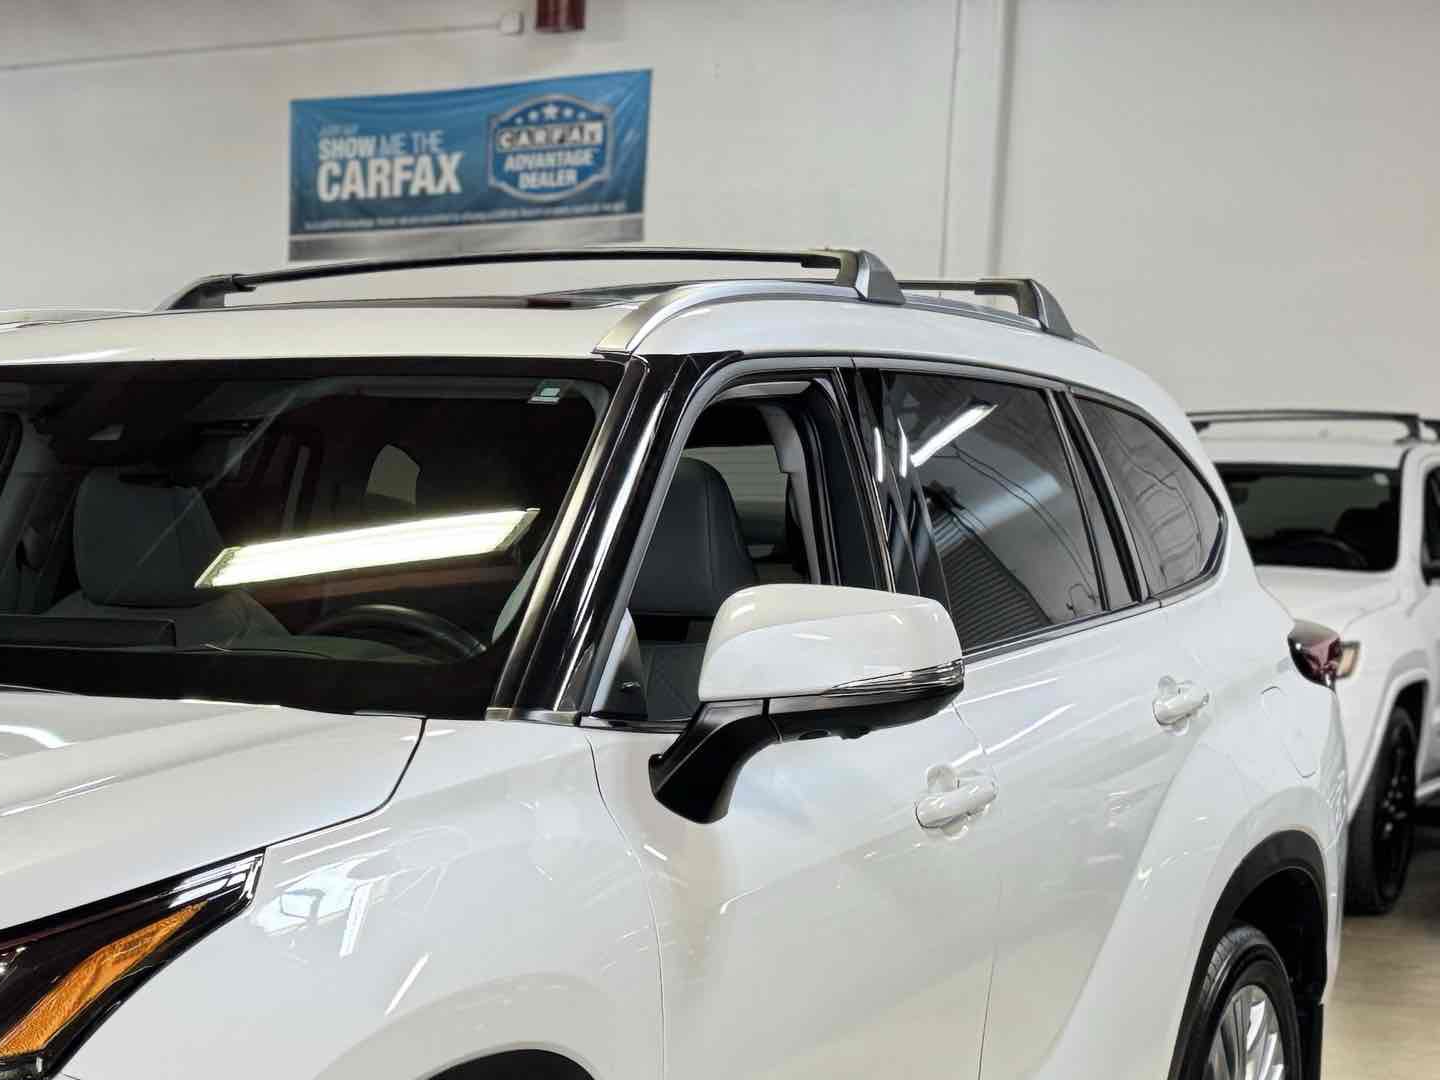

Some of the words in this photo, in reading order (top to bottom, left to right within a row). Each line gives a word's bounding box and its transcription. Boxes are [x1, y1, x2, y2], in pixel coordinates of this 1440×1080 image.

[319, 135, 376, 160] SHOW
[379, 132, 407, 157] ME
[412, 128, 445, 153] THE
[497, 121, 603, 151] CARFAX
[318, 151, 462, 201] CARFAX
[504, 149, 594, 173] ADVANTAGE
[518, 169, 578, 190] DEALER
